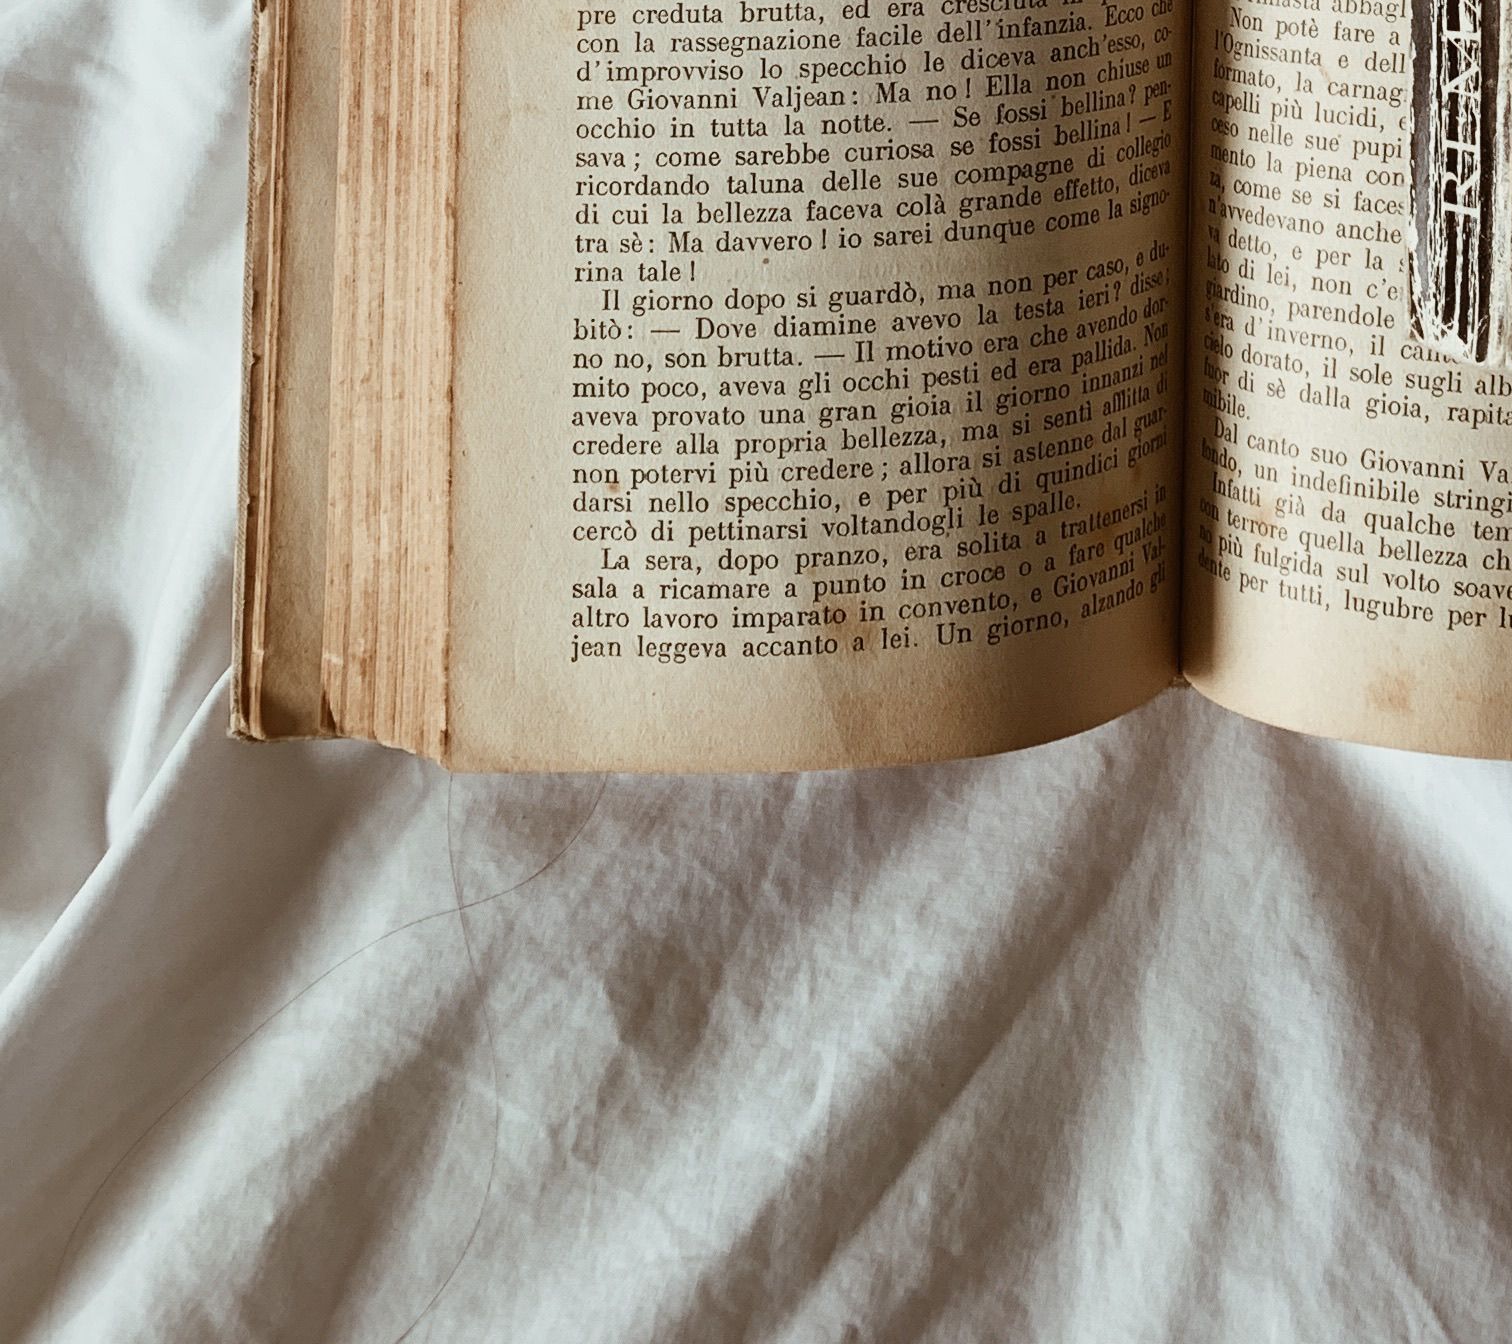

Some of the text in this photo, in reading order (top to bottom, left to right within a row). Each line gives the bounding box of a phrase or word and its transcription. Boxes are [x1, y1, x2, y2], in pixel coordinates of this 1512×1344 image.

[1241, 344, 1309, 377] dorato,
[1324, 358, 1336, 378] il
[1350, 364, 1392, 385] sole
[1406, 371, 1461, 397] sugli
[573, 434, 661, 455] credere
[677, 433, 719, 454] alla
[735, 431, 827, 460] propria
[841, 426, 945, 450] bellezza,
[962, 424, 1001, 441] ma
[1010, 413, 1032, 436] si
[1044, 400, 1092, 430] sentì
[1213, 417, 1238, 445] Dal
[1248, 435, 1298, 457] canto
[1312, 448, 1346, 466] suo
[1361, 449, 1463, 480] Giovanni
[1240, 573, 1267, 592] per
[1279, 580, 1330, 611] tutti,
[1345, 590, 1433, 621] lugubre
[1448, 609, 1486, 630] per
